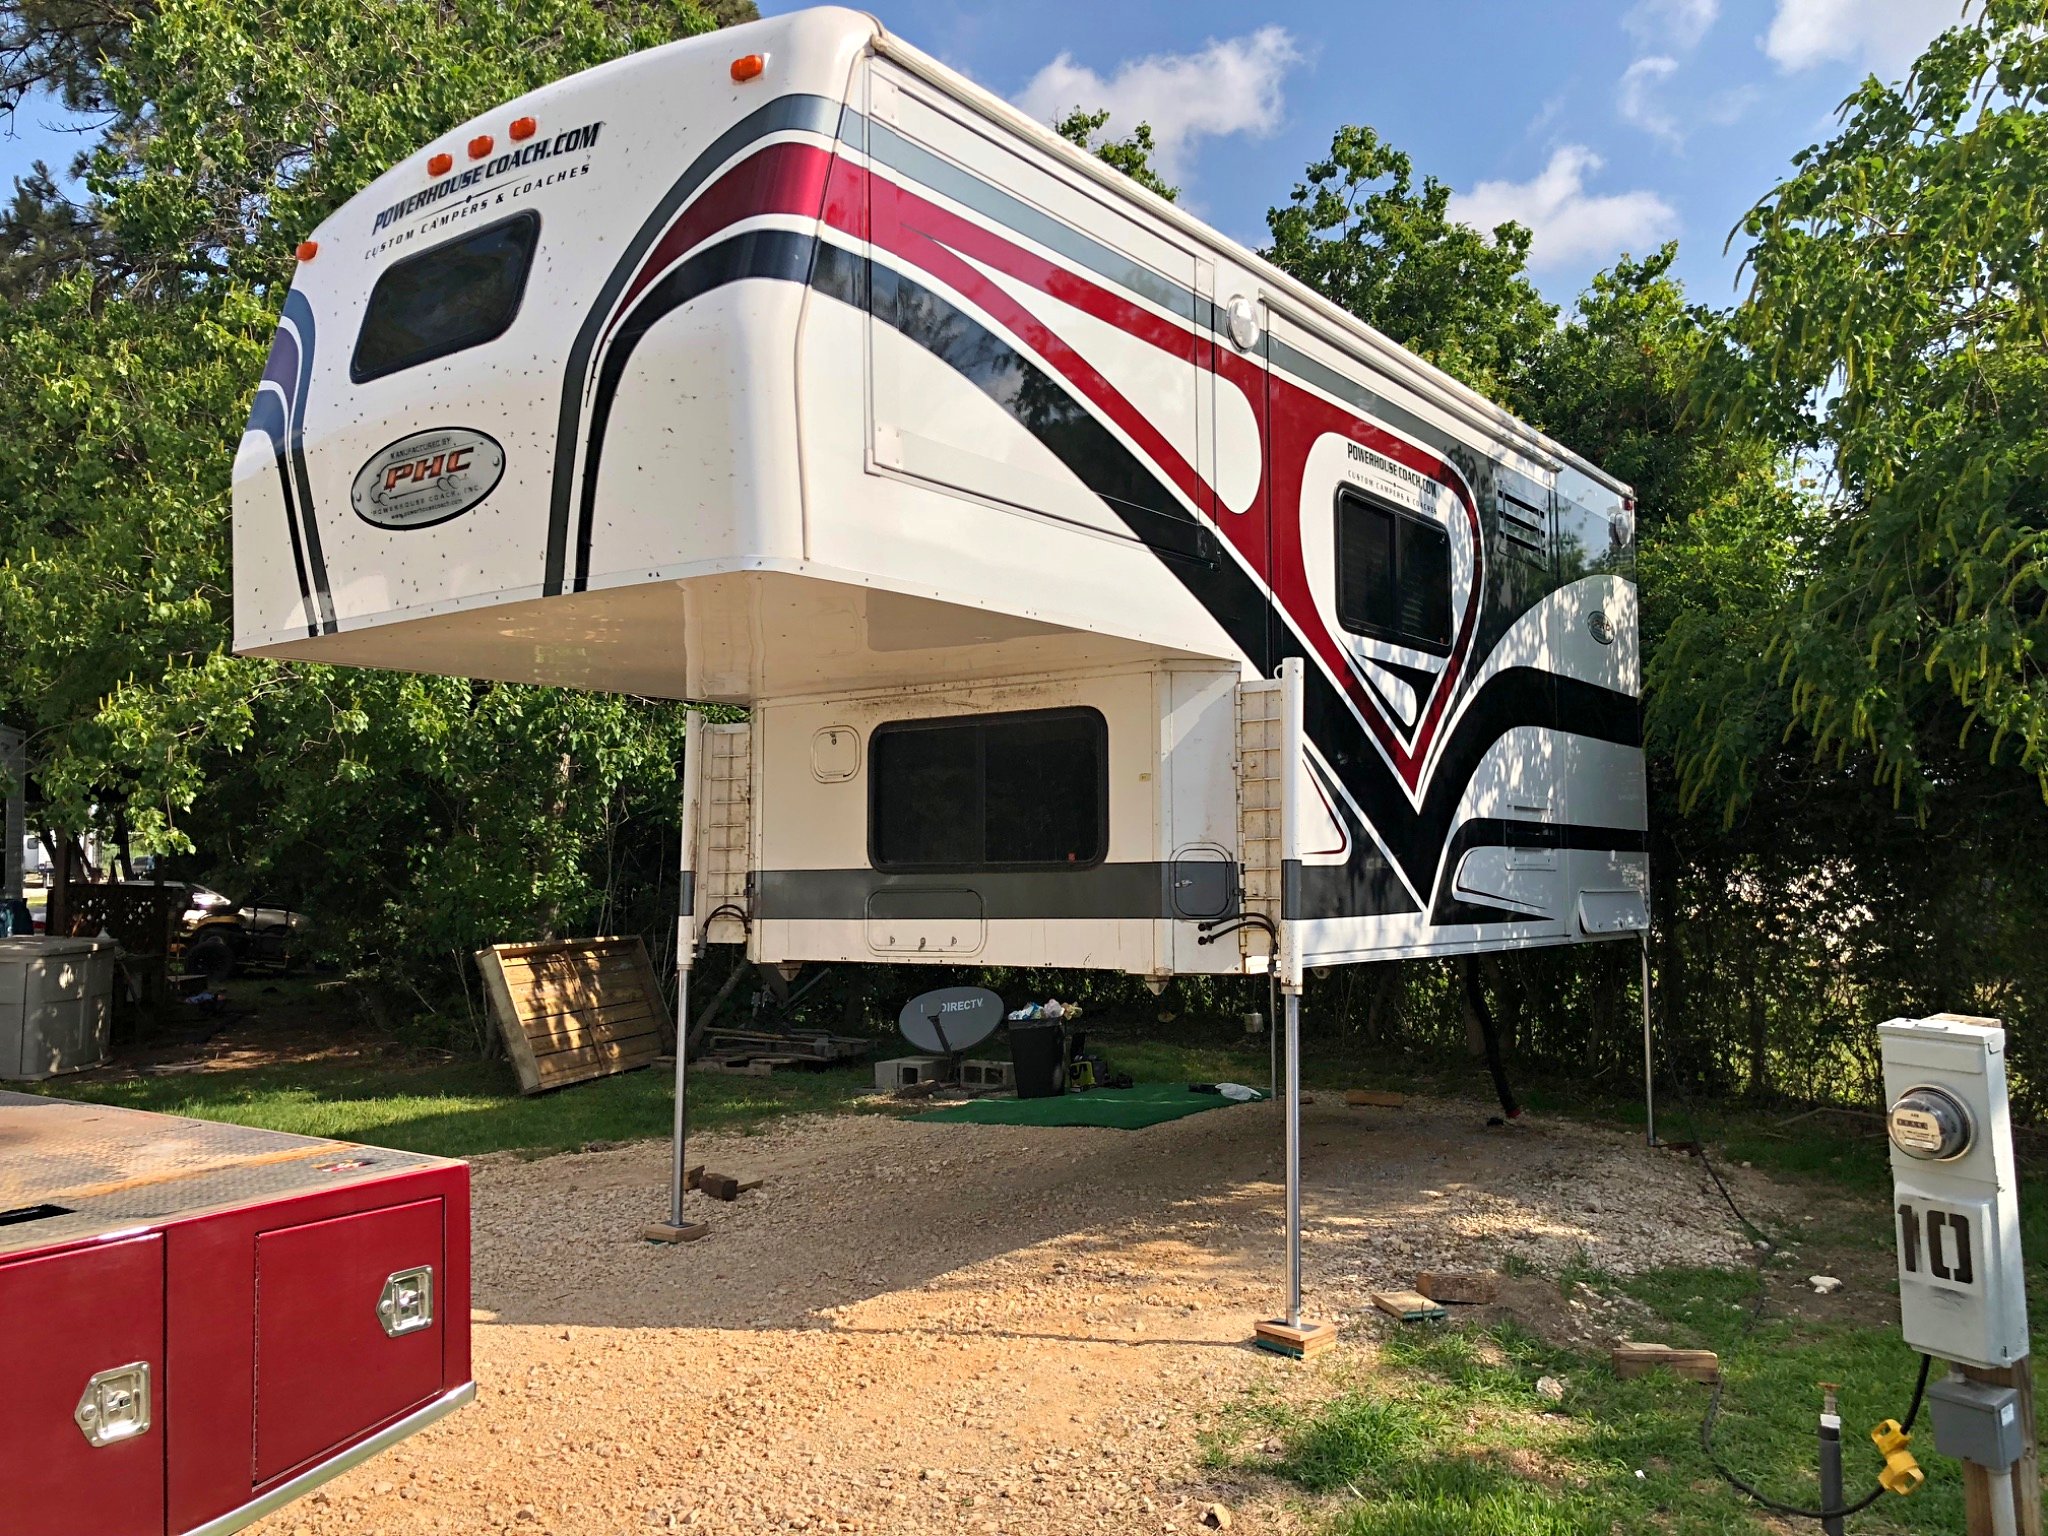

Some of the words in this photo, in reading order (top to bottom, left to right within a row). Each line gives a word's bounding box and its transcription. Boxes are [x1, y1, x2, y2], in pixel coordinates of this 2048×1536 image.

[364, 229, 415, 260] CUSTOM
[420, 199, 489, 234] CAMPERS
[495, 193, 504, 204] &
[513, 163, 590, 198] COACHES
[384, 446, 475, 491] PHC
[1347, 470, 1373, 486] CUSTOM
[372, 497, 425, 516] POWERHOUSE
[1897, 1204, 1974, 1285] 10
